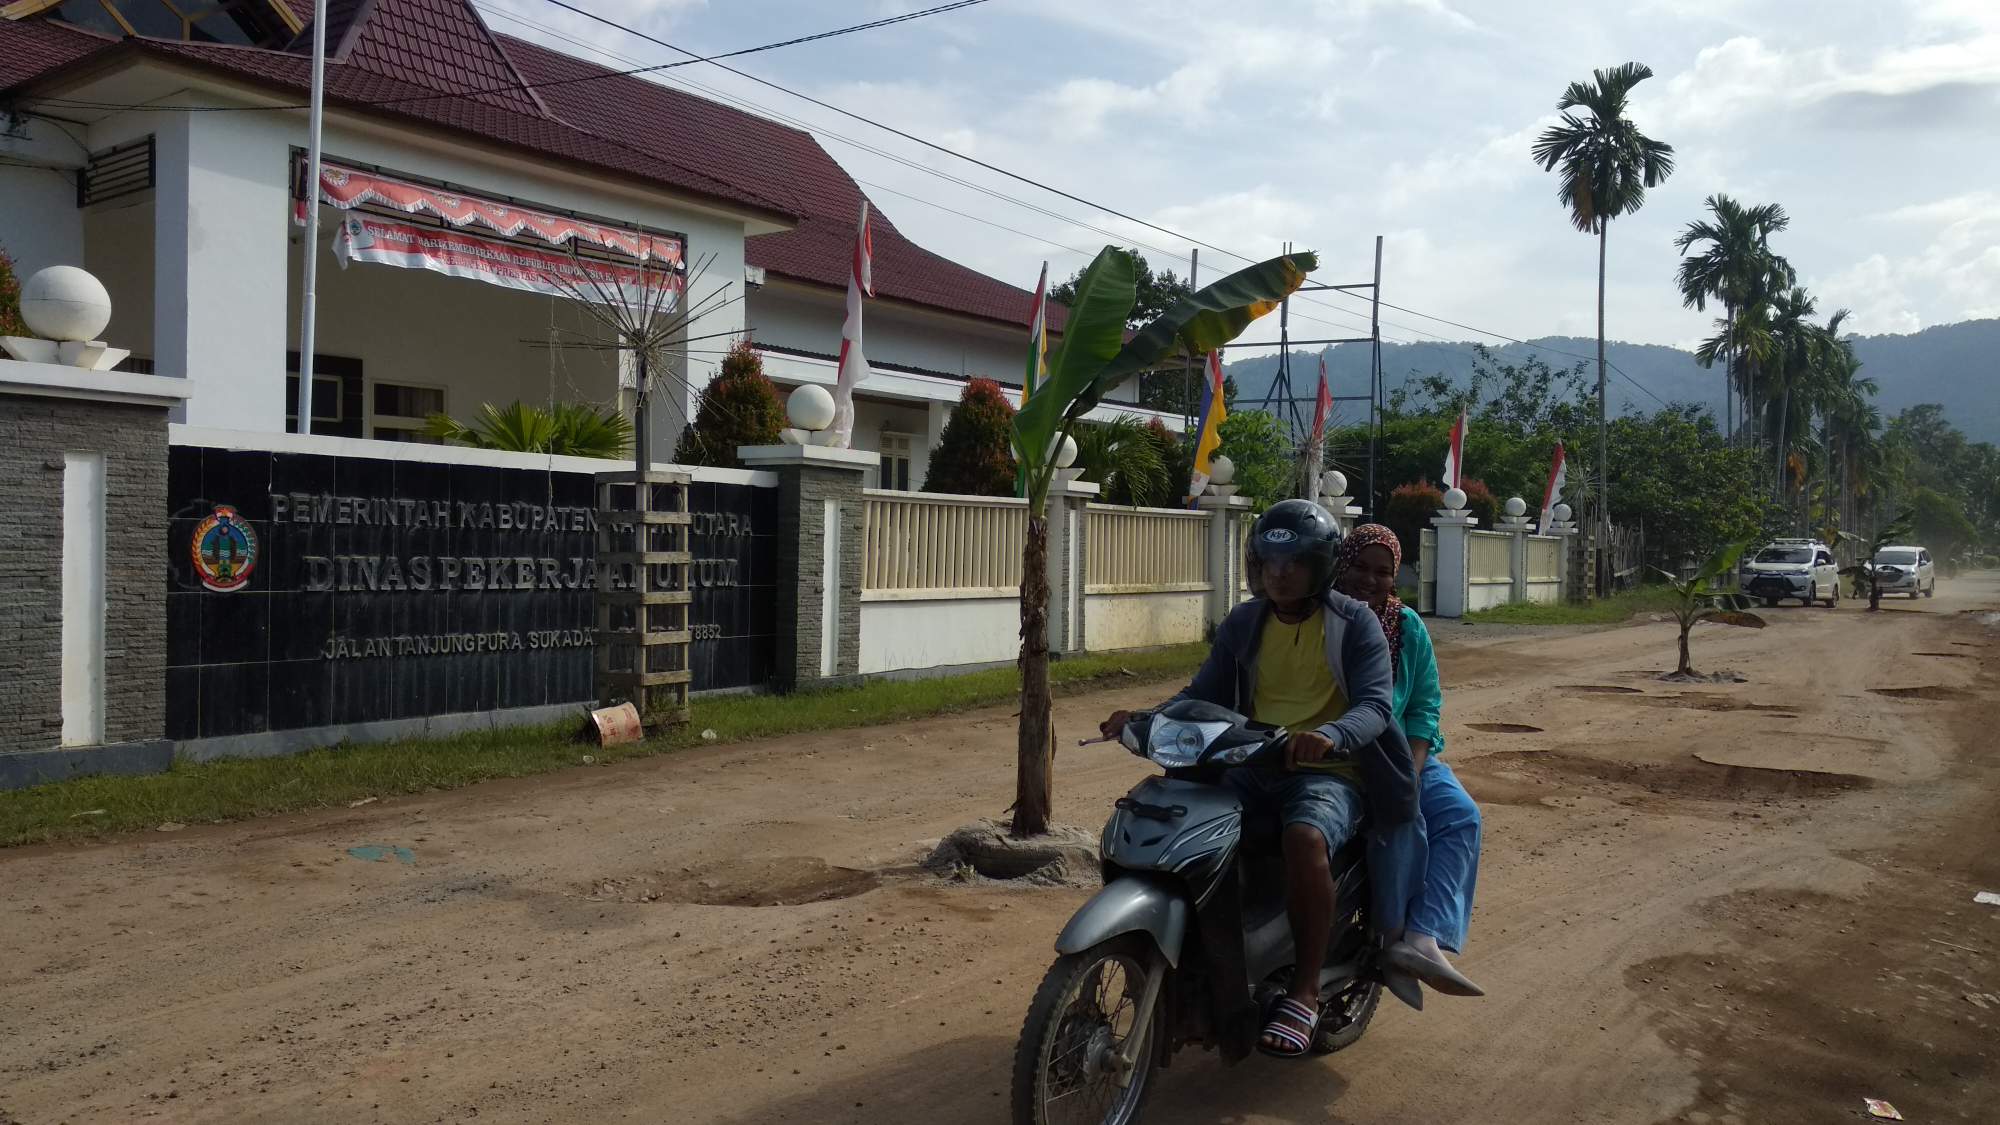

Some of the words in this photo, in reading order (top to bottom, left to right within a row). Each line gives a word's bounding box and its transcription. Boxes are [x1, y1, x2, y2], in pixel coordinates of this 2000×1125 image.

[367, 225, 414, 243] SELAMAT
[513, 255, 557, 273] REPUBLIK
[559, 262, 603, 280] INDONSIA
[271, 493, 450, 528] PEMERINTAH
[457, 501, 599, 533] KABUPATEN
[691, 511, 752, 537] UTARA
[303, 555, 431, 591] DINAS
[326, 636, 391, 660] JALAN
